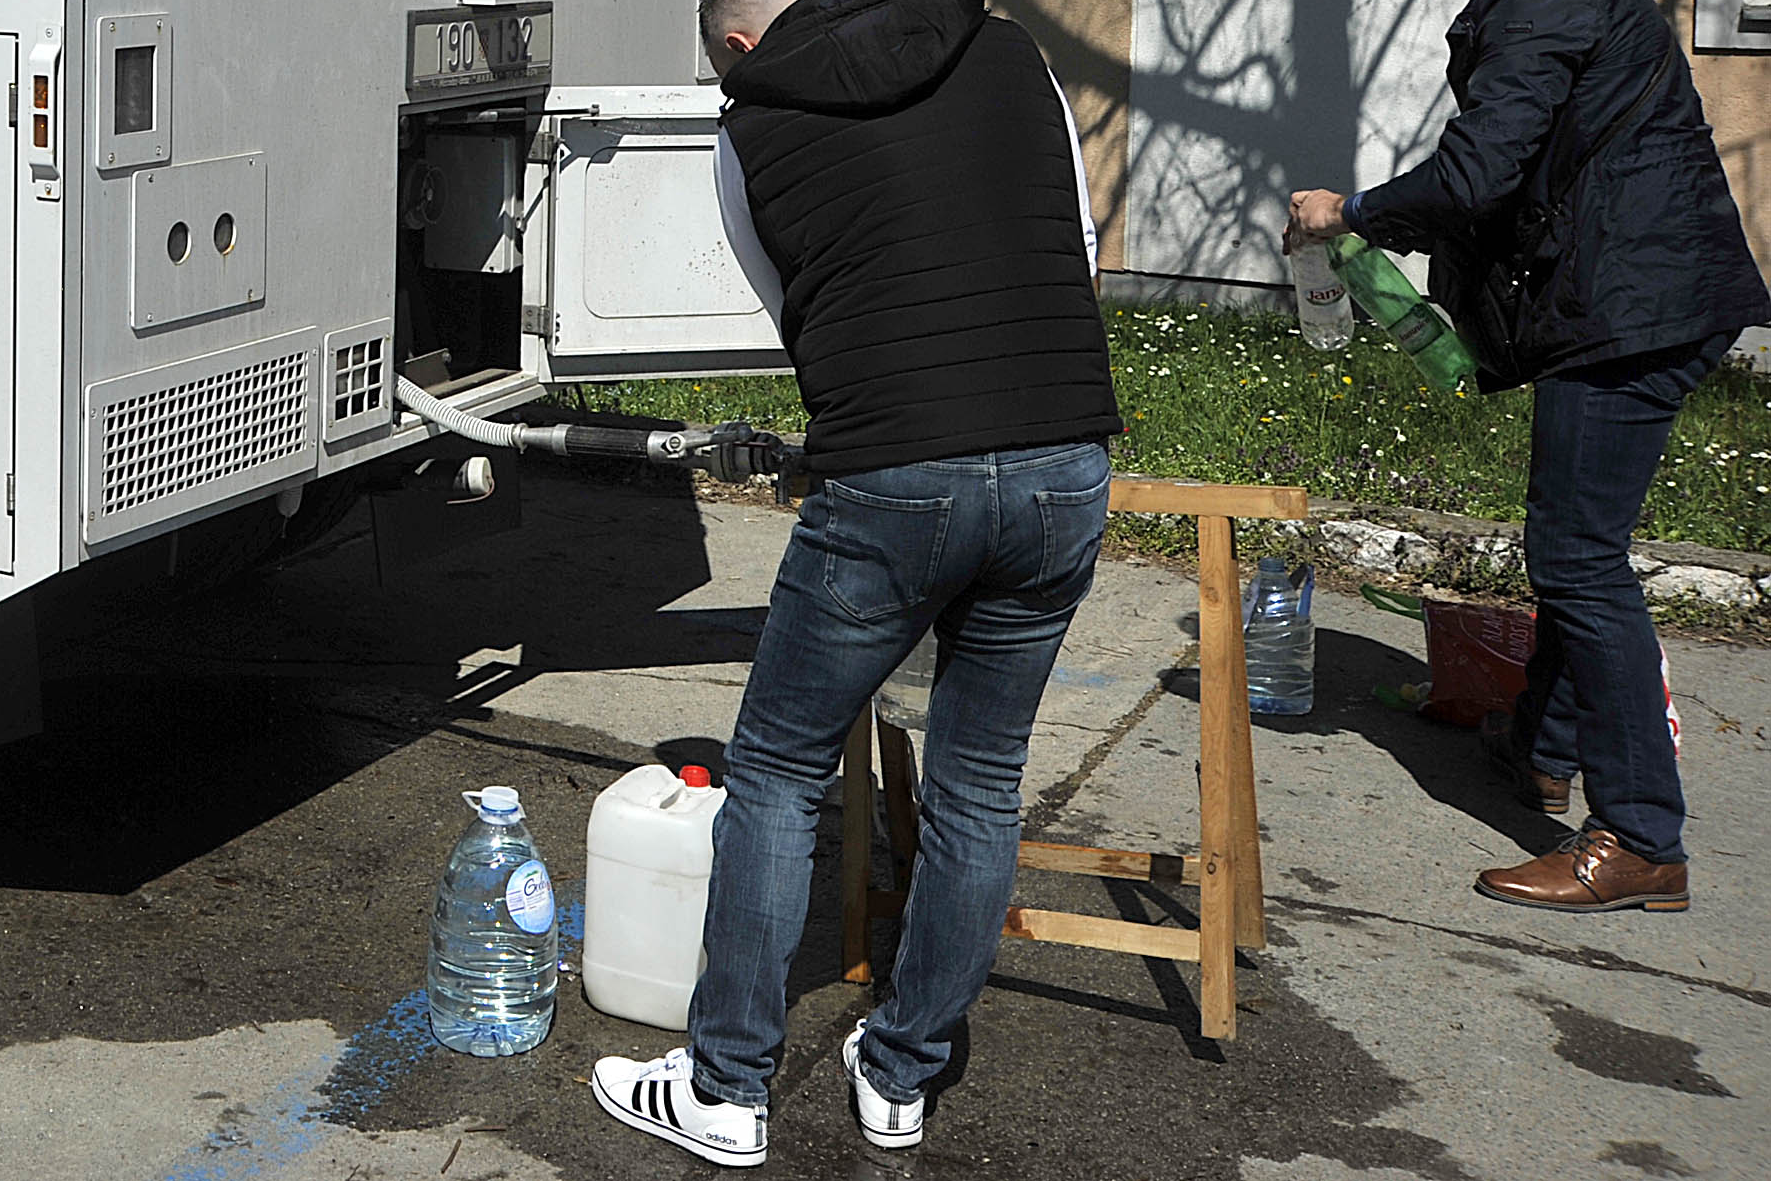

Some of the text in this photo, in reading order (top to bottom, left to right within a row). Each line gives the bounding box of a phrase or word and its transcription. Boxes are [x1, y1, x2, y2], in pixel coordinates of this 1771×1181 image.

[436, 16, 533, 74] 190 132
[705, 1131, 738, 1147] adidas
